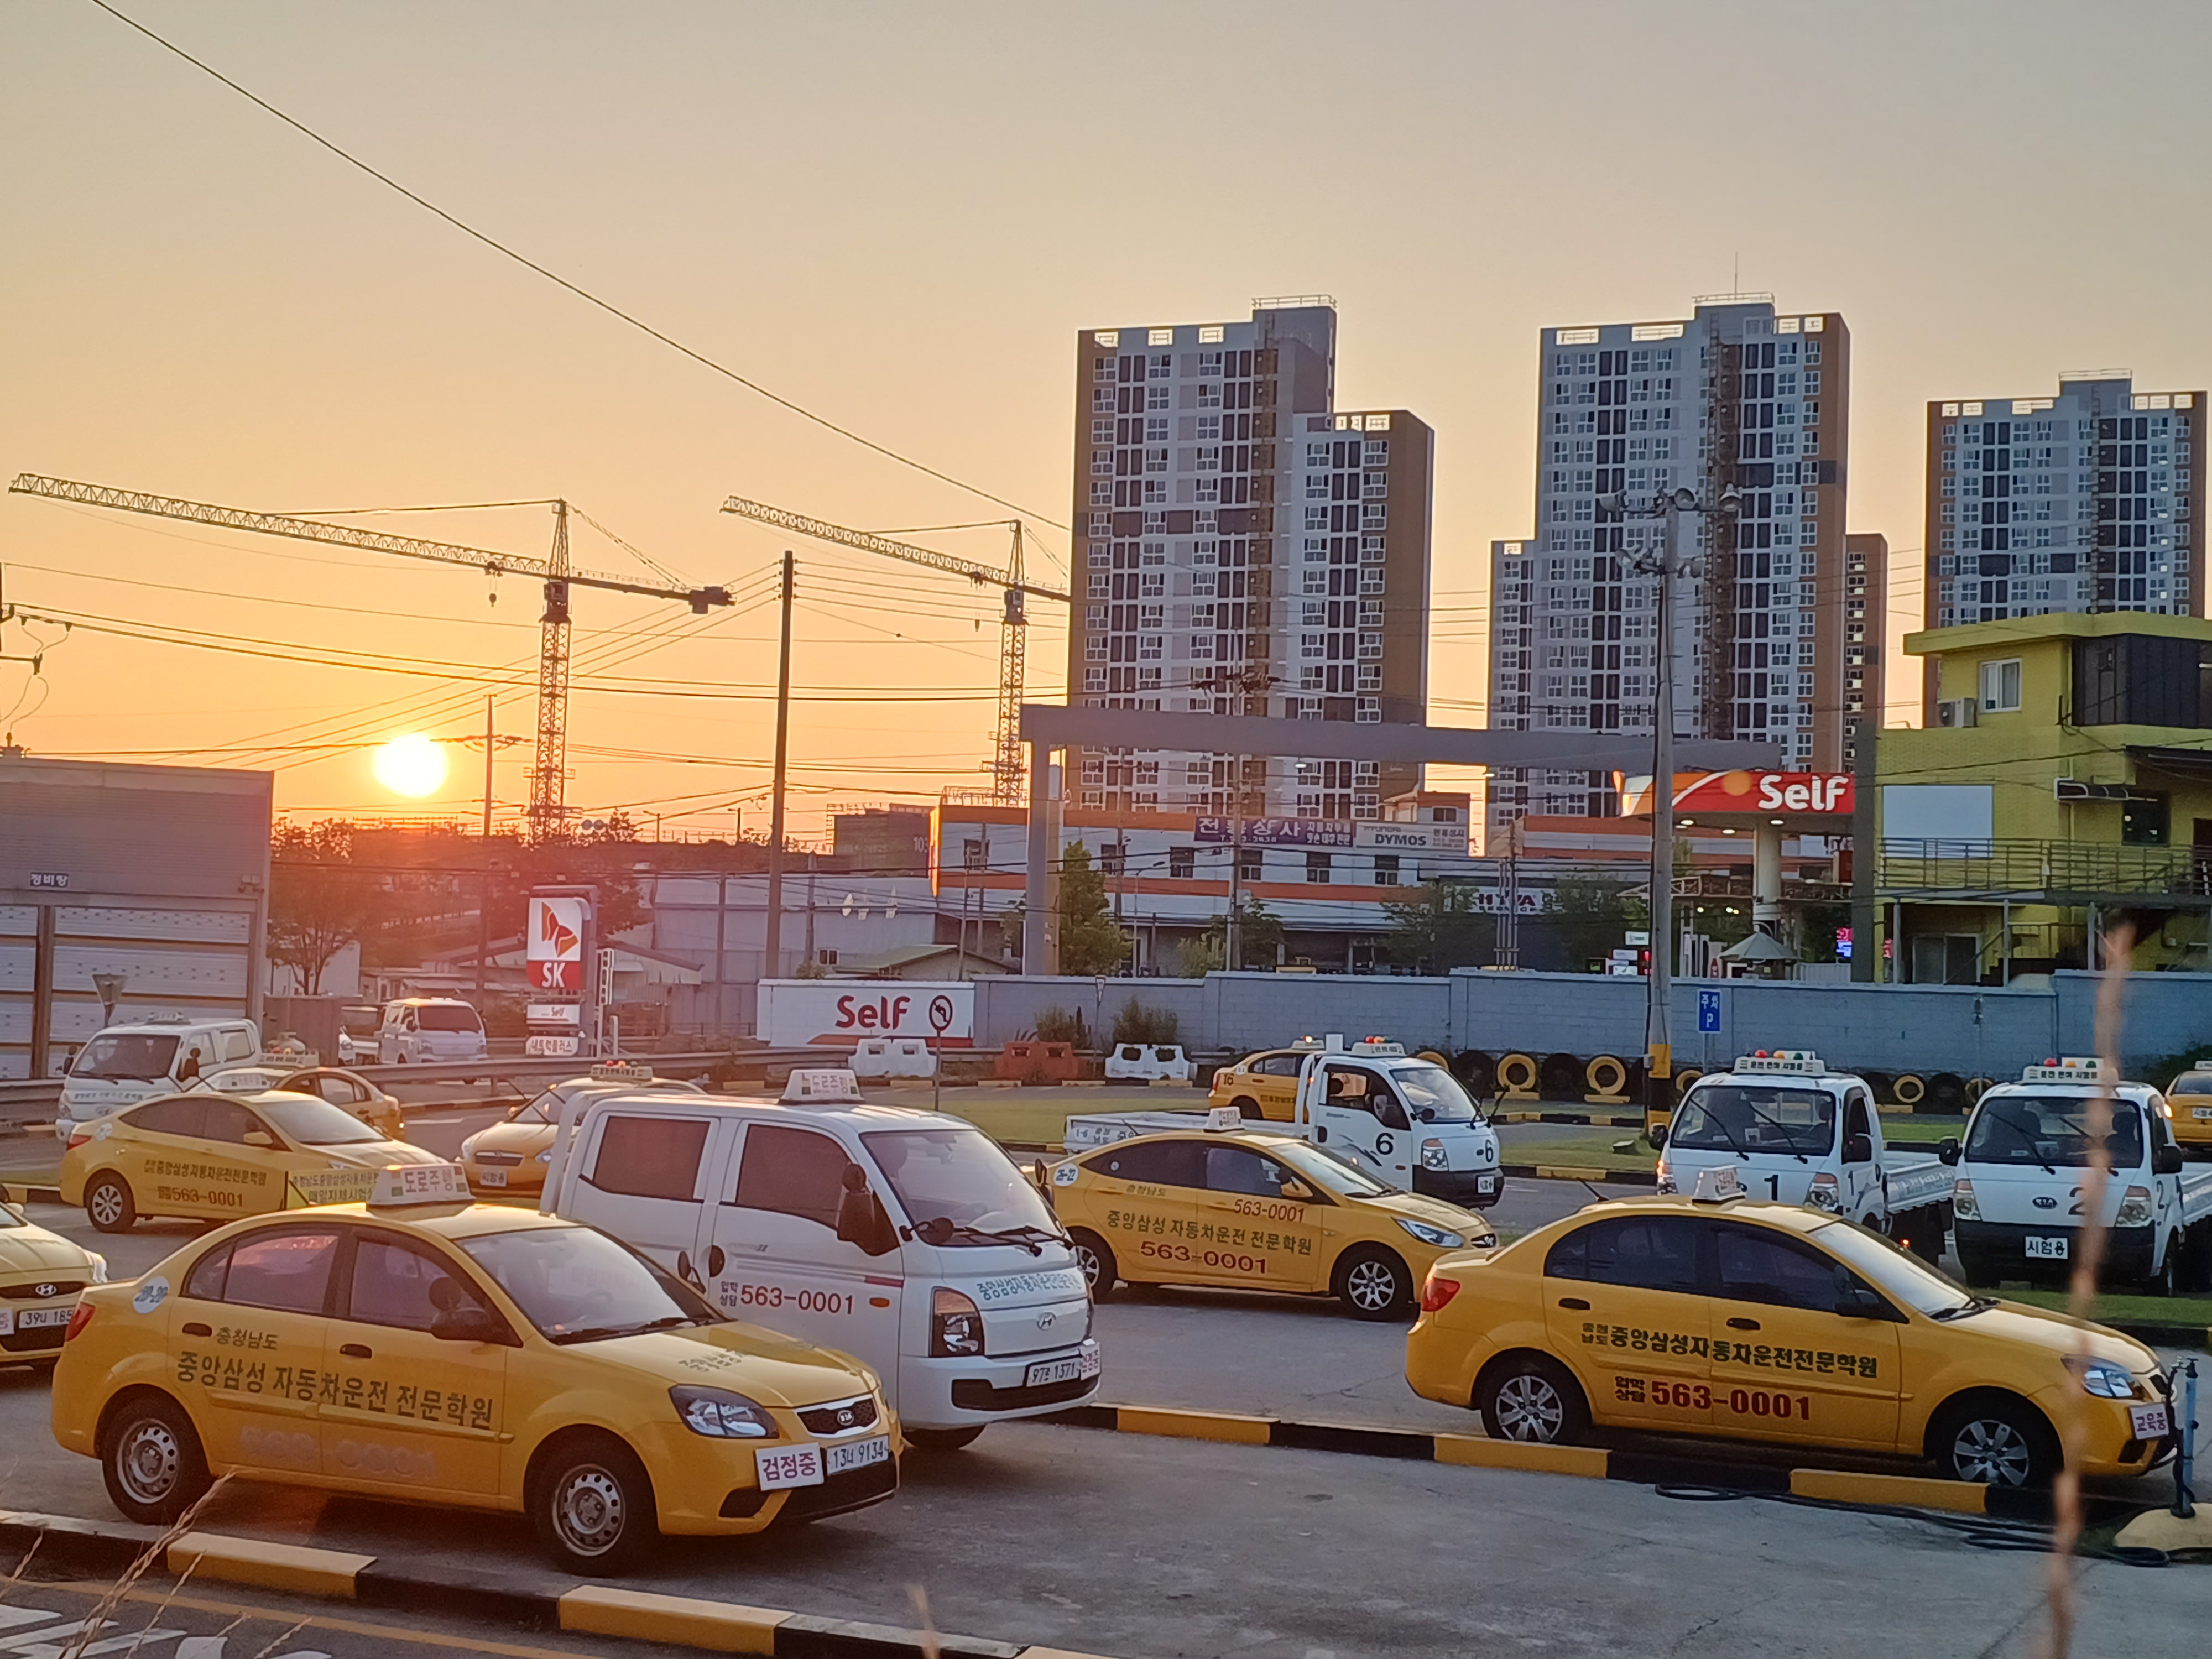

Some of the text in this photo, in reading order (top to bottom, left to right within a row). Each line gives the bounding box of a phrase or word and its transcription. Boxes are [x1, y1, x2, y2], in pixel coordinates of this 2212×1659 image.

[1757, 773, 1849, 811] Self
[1375, 833, 1427, 846] DYMOS
[542, 962, 565, 988] SK
[835, 995, 911, 1030] Self
[1700, 994, 1718, 1010] 주차
[1706, 1013, 1714, 1028] P
[1223, 1073, 1235, 1086] 16
[1375, 1133, 1395, 1155] 6
[1485, 1139, 1494, 1163] 6
[404, 1168, 453, 1193] 도로주행
[1126, 1184, 1167, 1197] 충청남도
[1764, 1175, 1779, 1201] 1
[1848, 1170, 1854, 1196] 1
[172, 1187, 243, 1207] 563-0001
[2157, 1180, 2165, 1210] 2
[1234, 1198, 1305, 1223] 563-0001
[1107, 1209, 1312, 1256] 중앙삼성 자동차운전 전문학원
[1140, 1240, 1267, 1274] 563-0001
[2027, 1240, 2065, 1256] 시험용
[740, 1285, 853, 1315] 563-0001
[54, 1309, 74, 1323] 185
[217, 1327, 279, 1350] 충청남도
[1610, 1325, 1877, 1378] 중앙삼성자동차운전전문학원
[1055, 1362, 1076, 1379] 1371
[177, 1351, 493, 1431] 중앙삼성 자동차운전 전문학원
[1614, 1376, 1646, 1390] 입학
[1614, 1389, 1646, 1404] 상담
[1651, 1380, 1809, 1421] 563-0001
[2135, 1412, 2166, 1432] 교육중
[858, 1441, 884, 1463] 9134
[762, 1452, 817, 1482] 검정중
